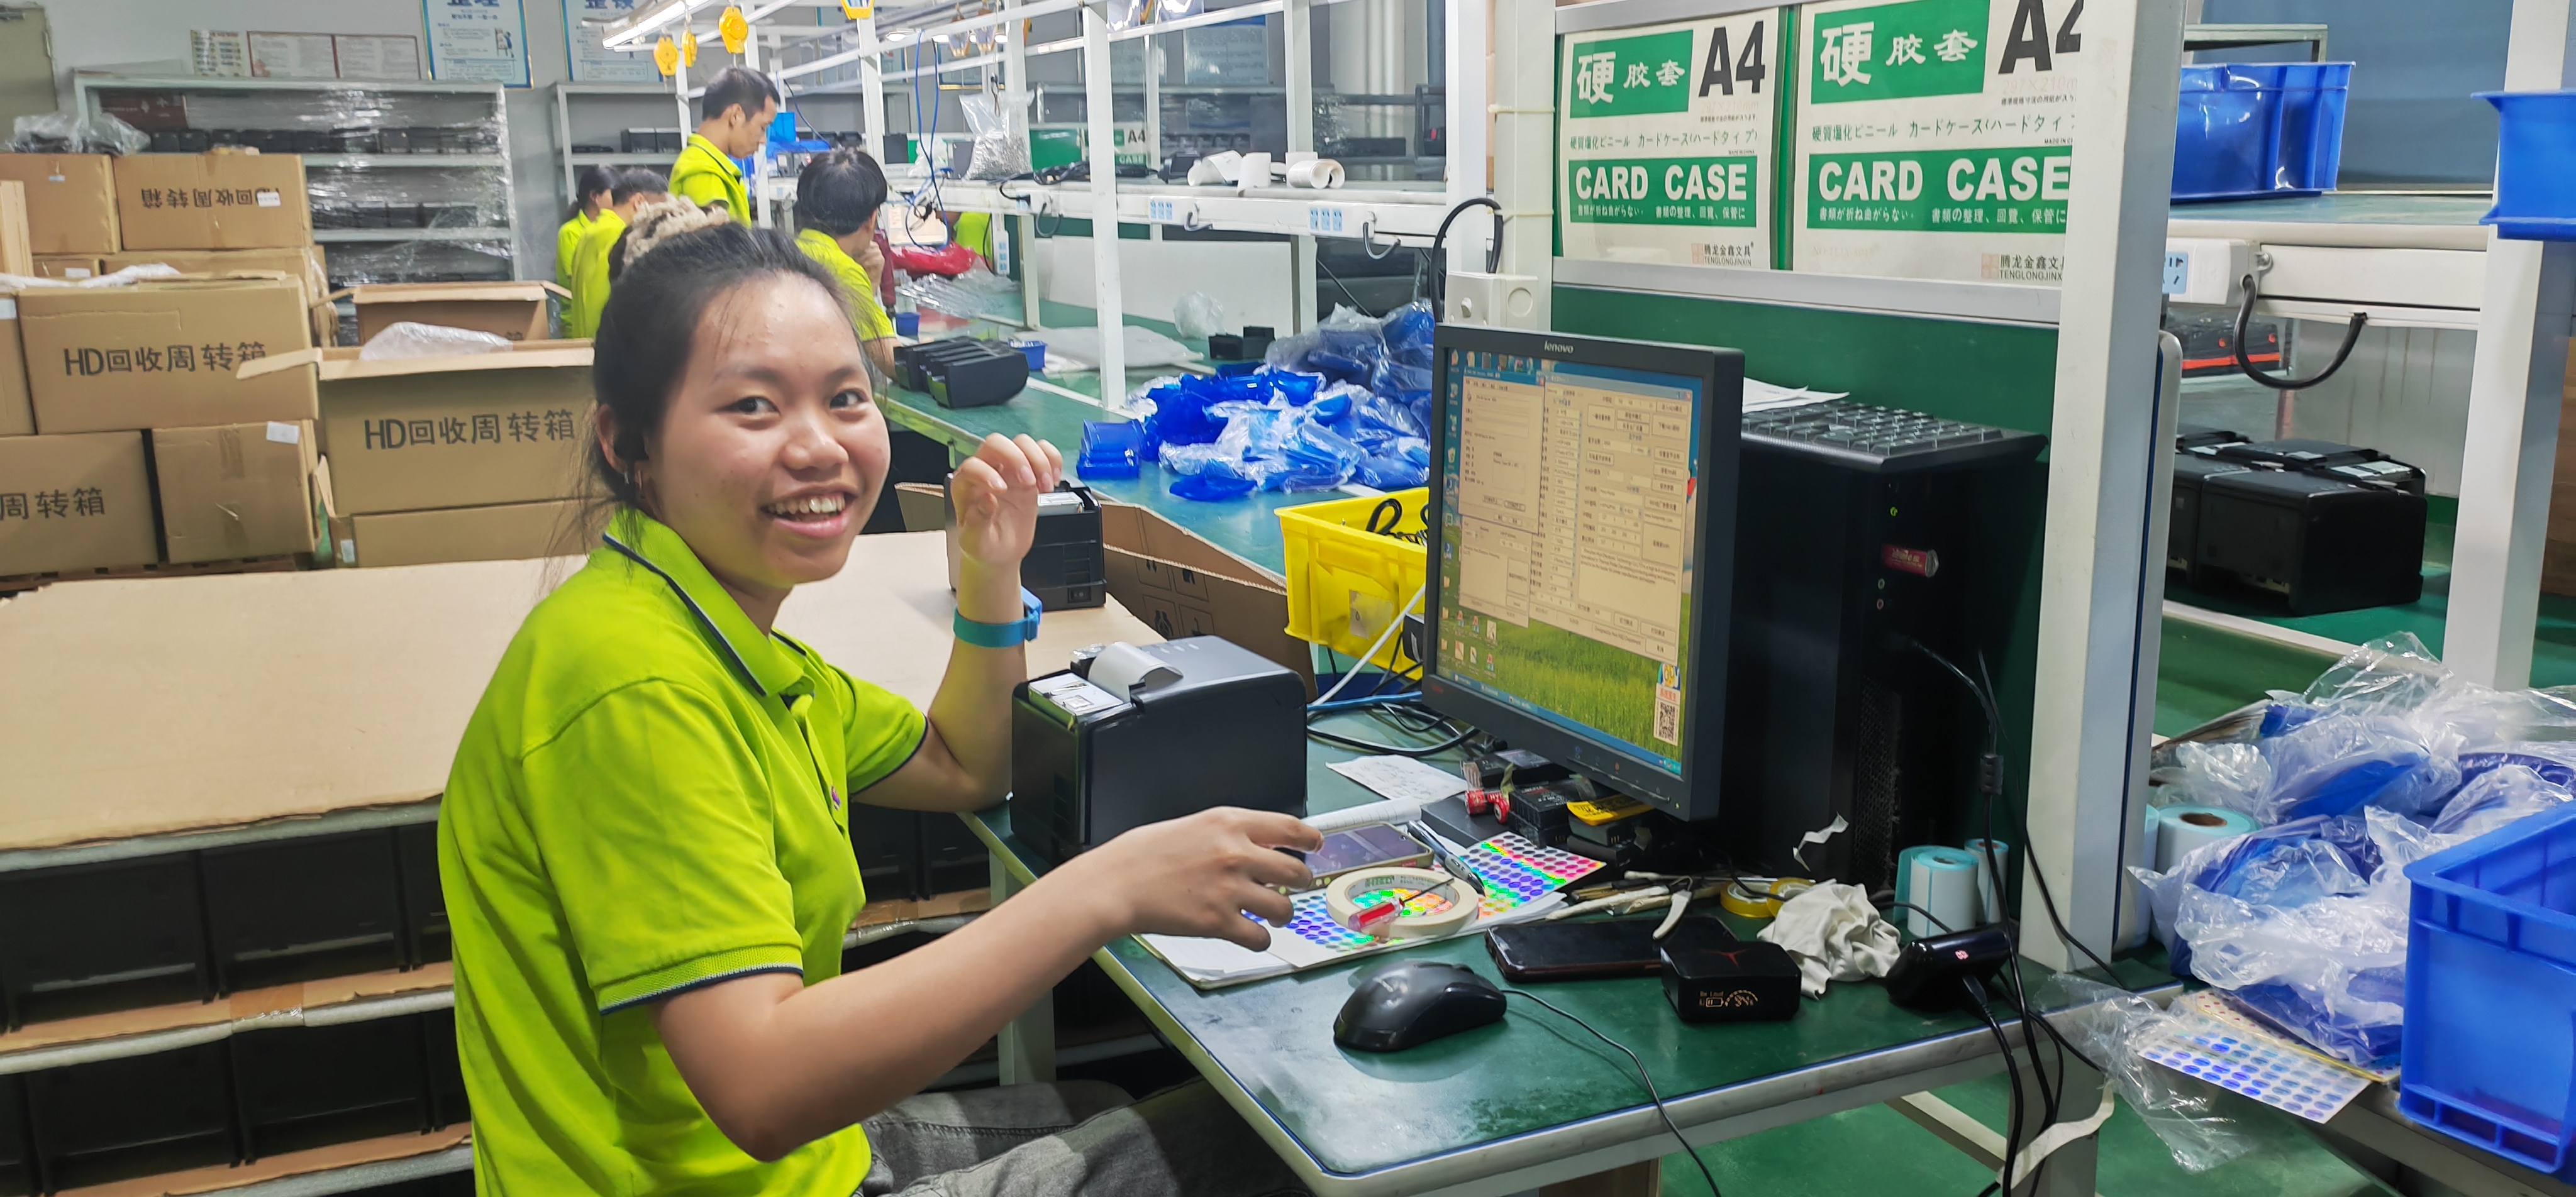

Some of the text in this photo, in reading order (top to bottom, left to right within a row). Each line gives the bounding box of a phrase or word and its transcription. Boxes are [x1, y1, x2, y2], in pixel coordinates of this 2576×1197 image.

[1698, 21, 1765, 97] A4
[1128, 129, 1145, 143] A4
[1909, 114, 2075, 138] カードケース(ハードタイ
[1576, 163, 1746, 201] CARD CASE
[1819, 156, 2070, 201] CARD CASE
[1544, 340, 1574, 354] lenovo
[364, 409, 575, 450] HD回收周转箱
[0, 487, 105, 521] 周转箱
